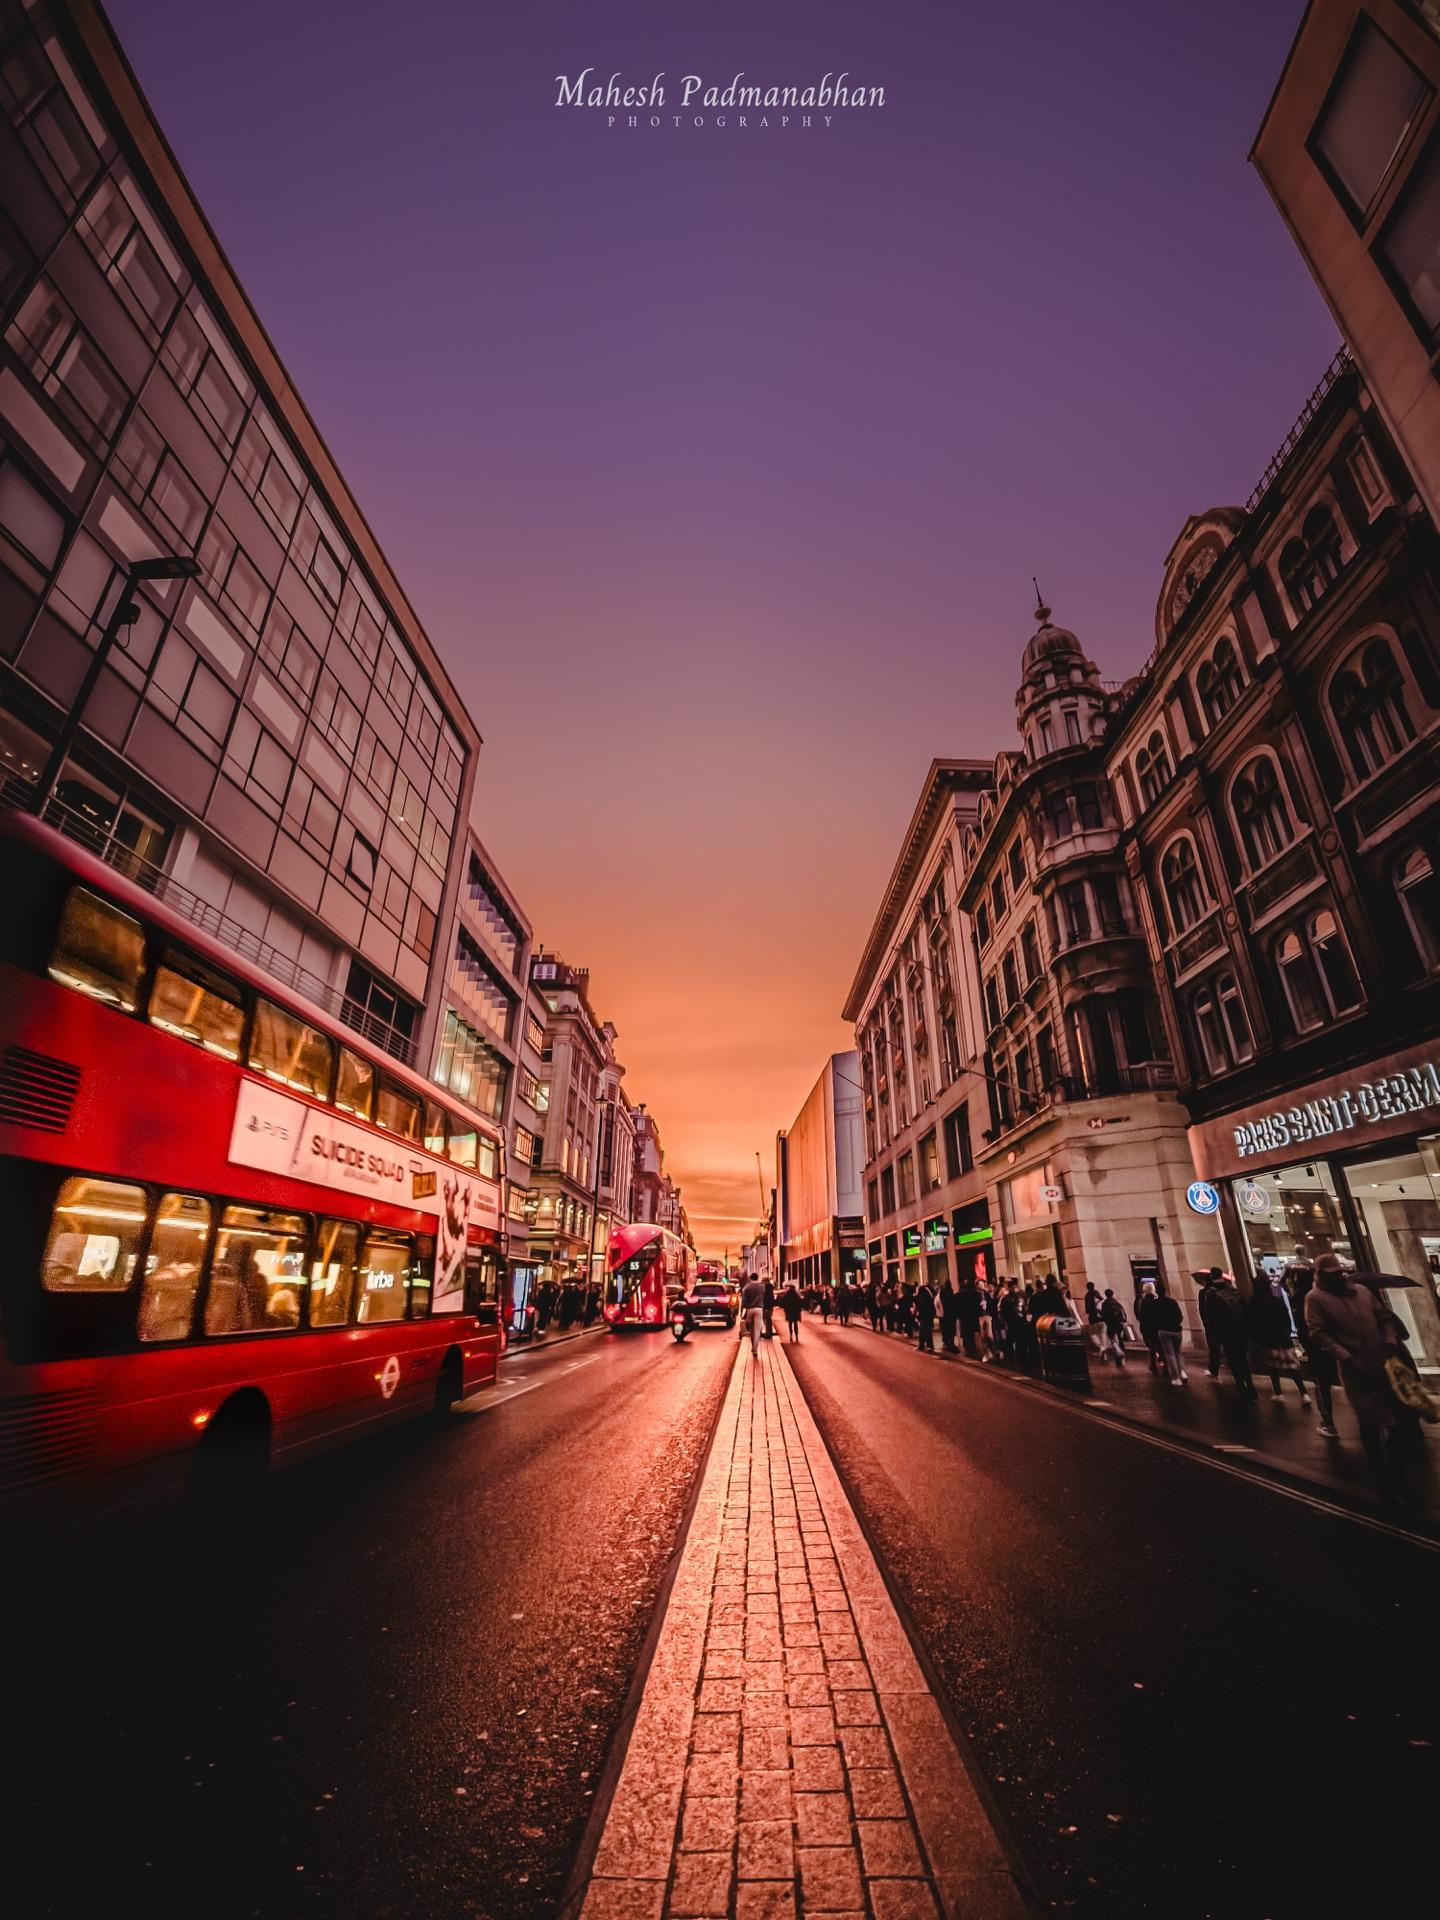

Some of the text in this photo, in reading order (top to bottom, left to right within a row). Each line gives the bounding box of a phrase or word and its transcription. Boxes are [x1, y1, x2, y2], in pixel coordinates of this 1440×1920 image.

[1233, 1112, 1291, 1158] PARIS
[311, 1135, 365, 1169] SUICIDE
[367, 1154, 404, 1183] SQUAD
